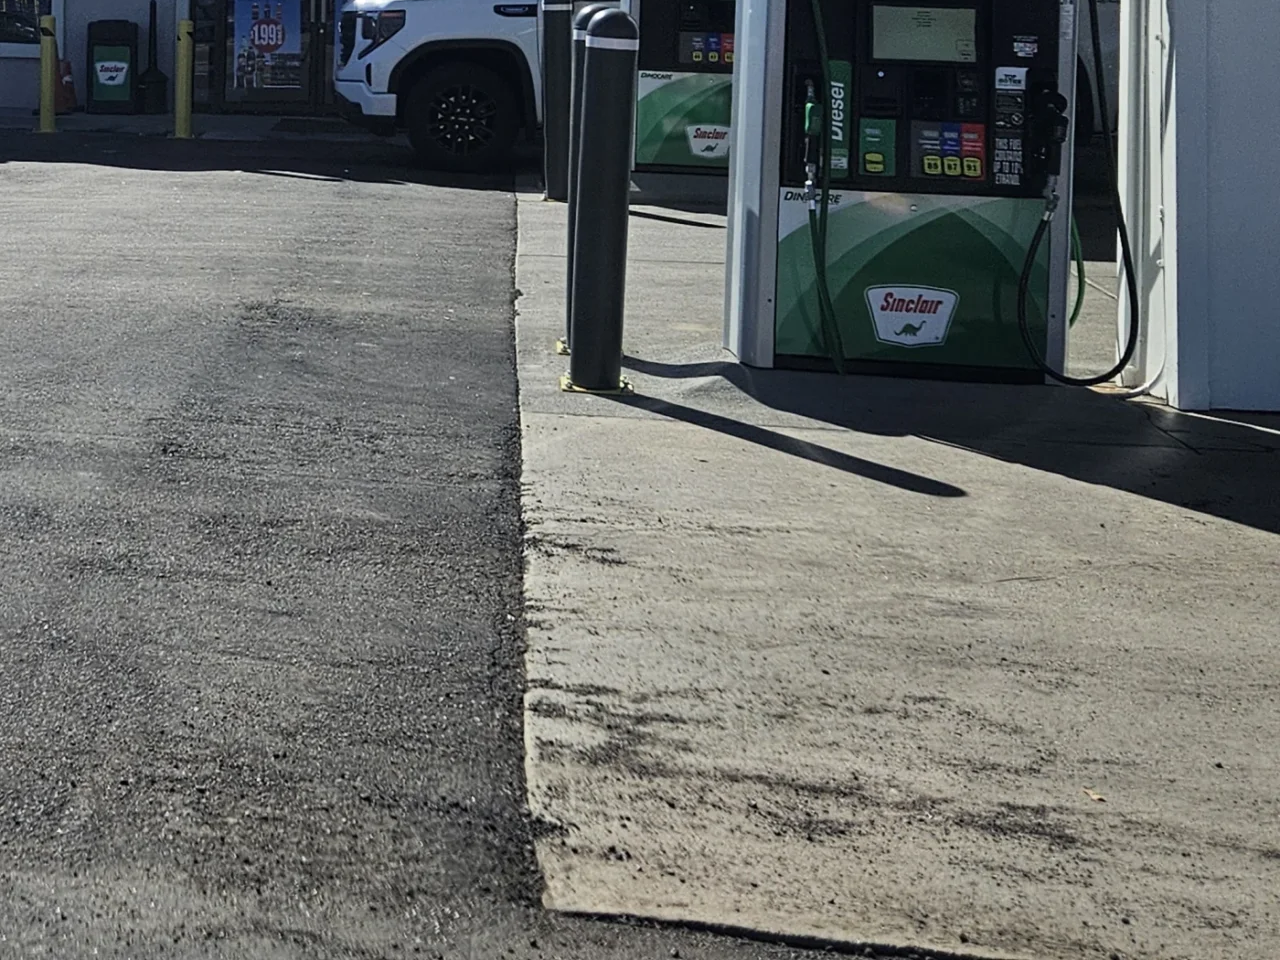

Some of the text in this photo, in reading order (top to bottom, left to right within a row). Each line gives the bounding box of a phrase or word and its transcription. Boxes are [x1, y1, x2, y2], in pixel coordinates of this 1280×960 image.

[99, 64, 125, 73] Sinclair
[693, 127, 728, 140] Sinclair
[784, 190, 842, 204] DINCRE
[880, 291, 944, 315] Sinclair
